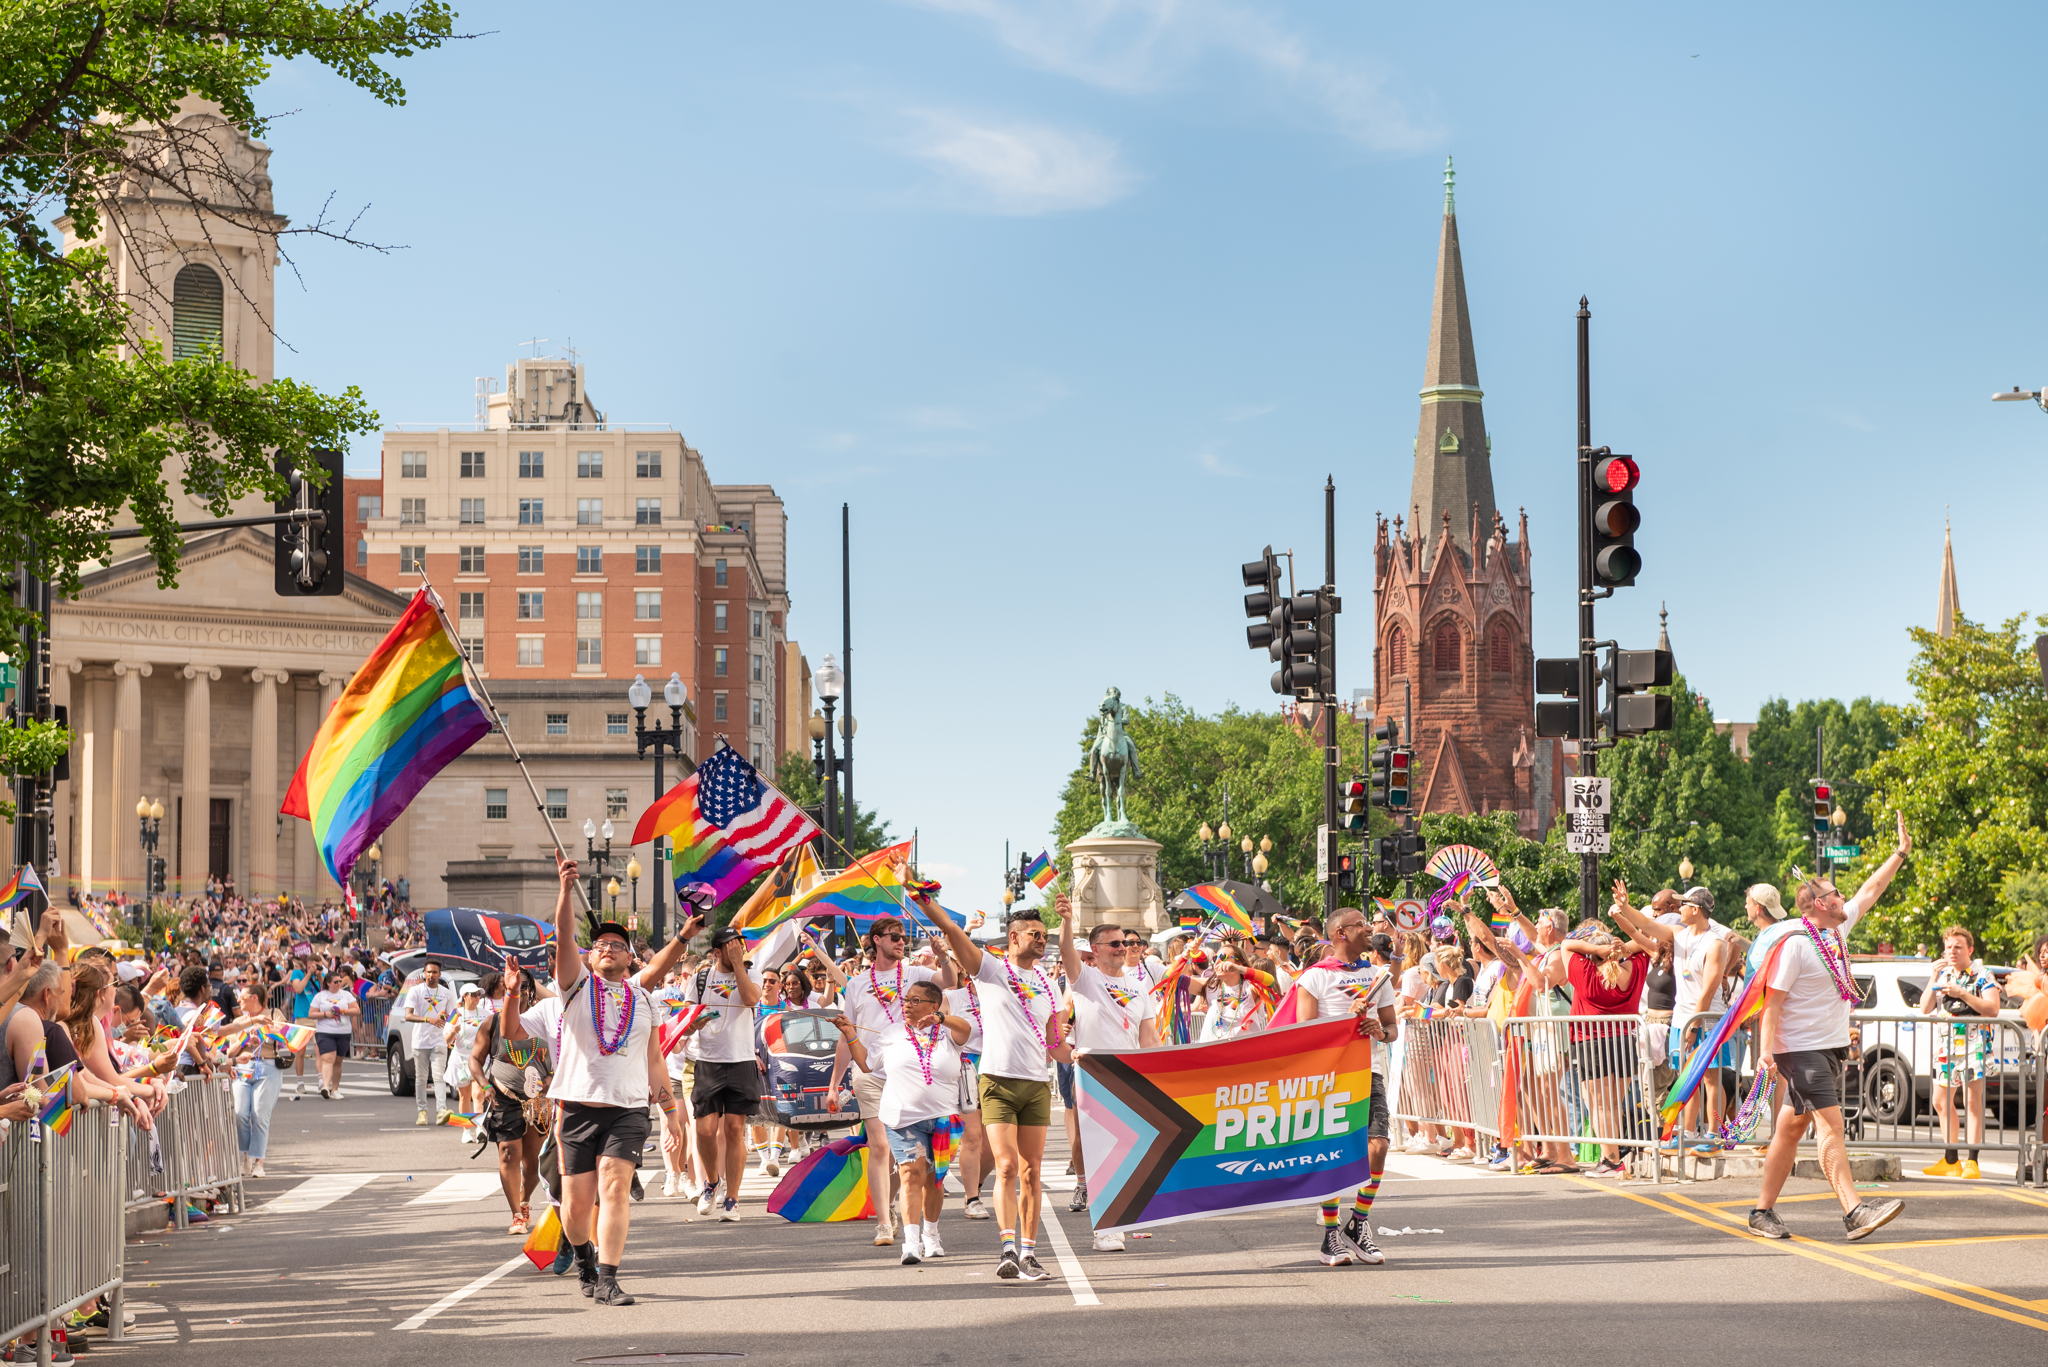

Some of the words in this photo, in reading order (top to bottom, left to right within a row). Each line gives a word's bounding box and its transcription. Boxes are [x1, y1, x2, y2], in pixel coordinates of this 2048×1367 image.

[80, 620, 169, 640] NATIONAL
[174, 626, 214, 641] CITY
[218, 628, 308, 648] CHRISTIAN
[1574, 784, 1602, 794] SAY
[1574, 794, 1603, 808] NO
[1339, 976, 1373, 985] AMTRA
[1215, 1081, 1270, 1108] RIDE
[1278, 1071, 1336, 1100] WITH
[1214, 1091, 1352, 1151] PRIDE
[1252, 1150, 1342, 1172] AMTRAK
